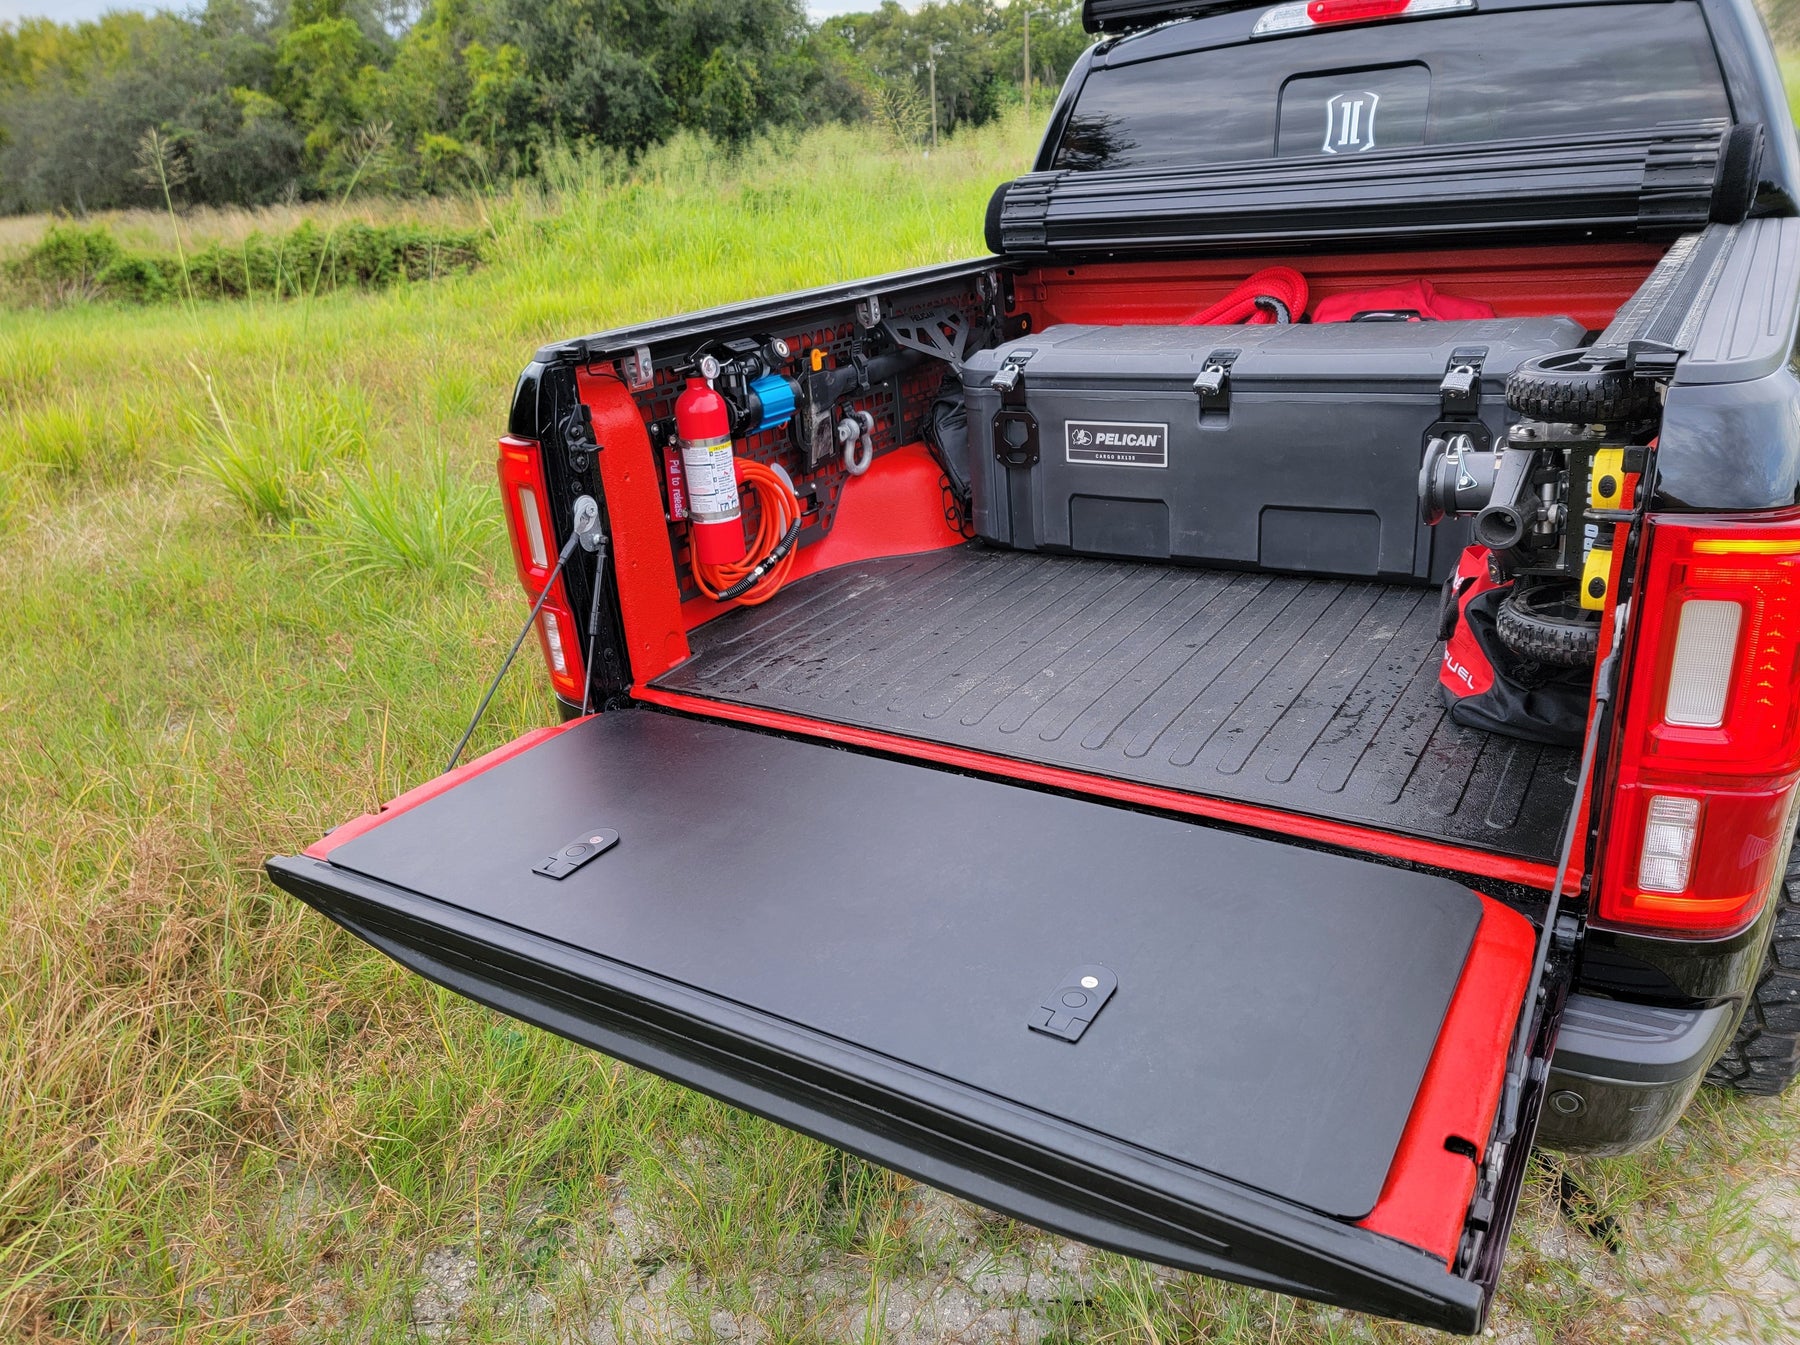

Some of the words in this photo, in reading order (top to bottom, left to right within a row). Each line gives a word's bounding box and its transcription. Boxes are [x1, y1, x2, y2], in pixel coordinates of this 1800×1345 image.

[1095, 432, 1158, 447] PELICAN
[669, 460, 681, 474] Pull
[672, 477, 681, 486] to
[672, 489, 684, 518] release
